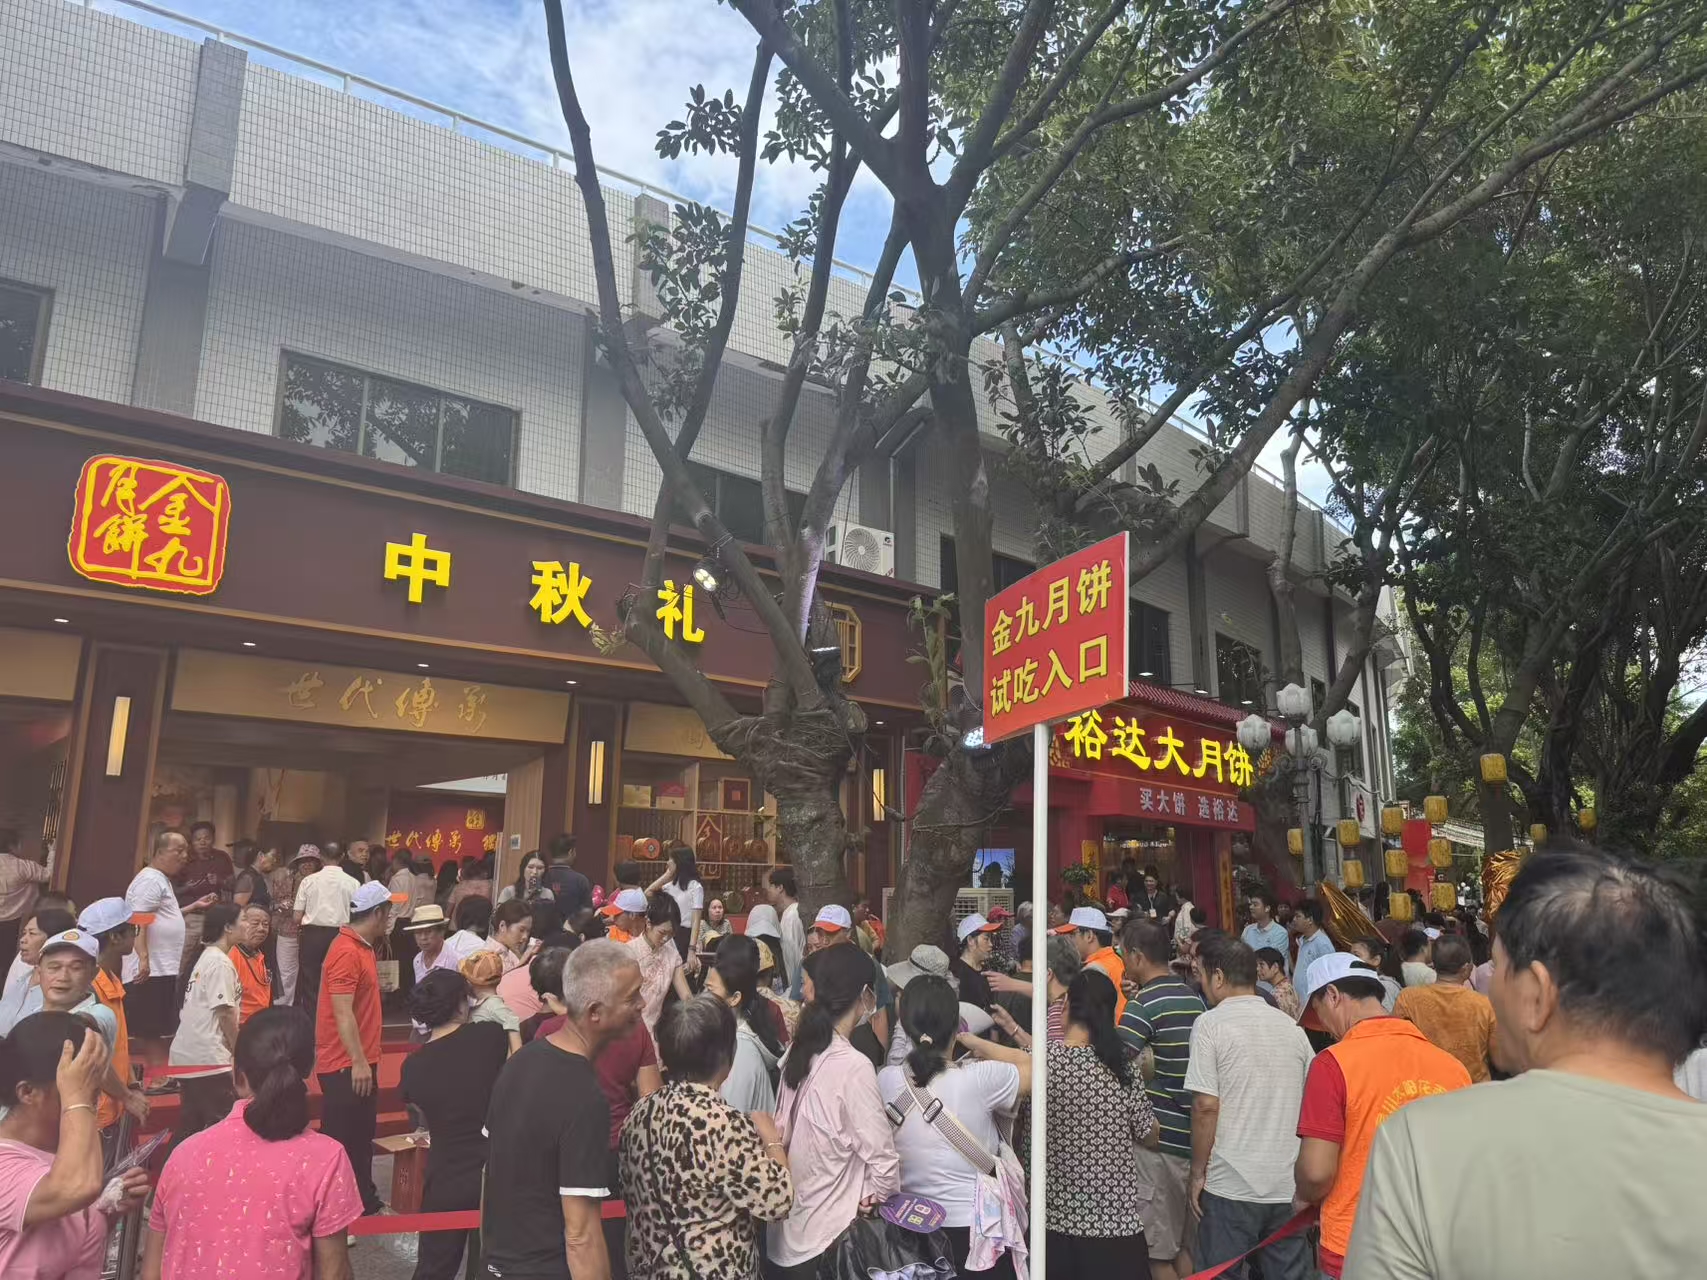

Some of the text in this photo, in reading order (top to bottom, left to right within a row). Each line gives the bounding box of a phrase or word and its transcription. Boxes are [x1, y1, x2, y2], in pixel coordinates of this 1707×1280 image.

[384, 532, 705, 645] 中秋礼
[990, 559, 1112, 656] 金九月饼
[989, 635, 1109, 718] 试吃入口
[1064, 709, 1254, 787] 裕达大月饼
